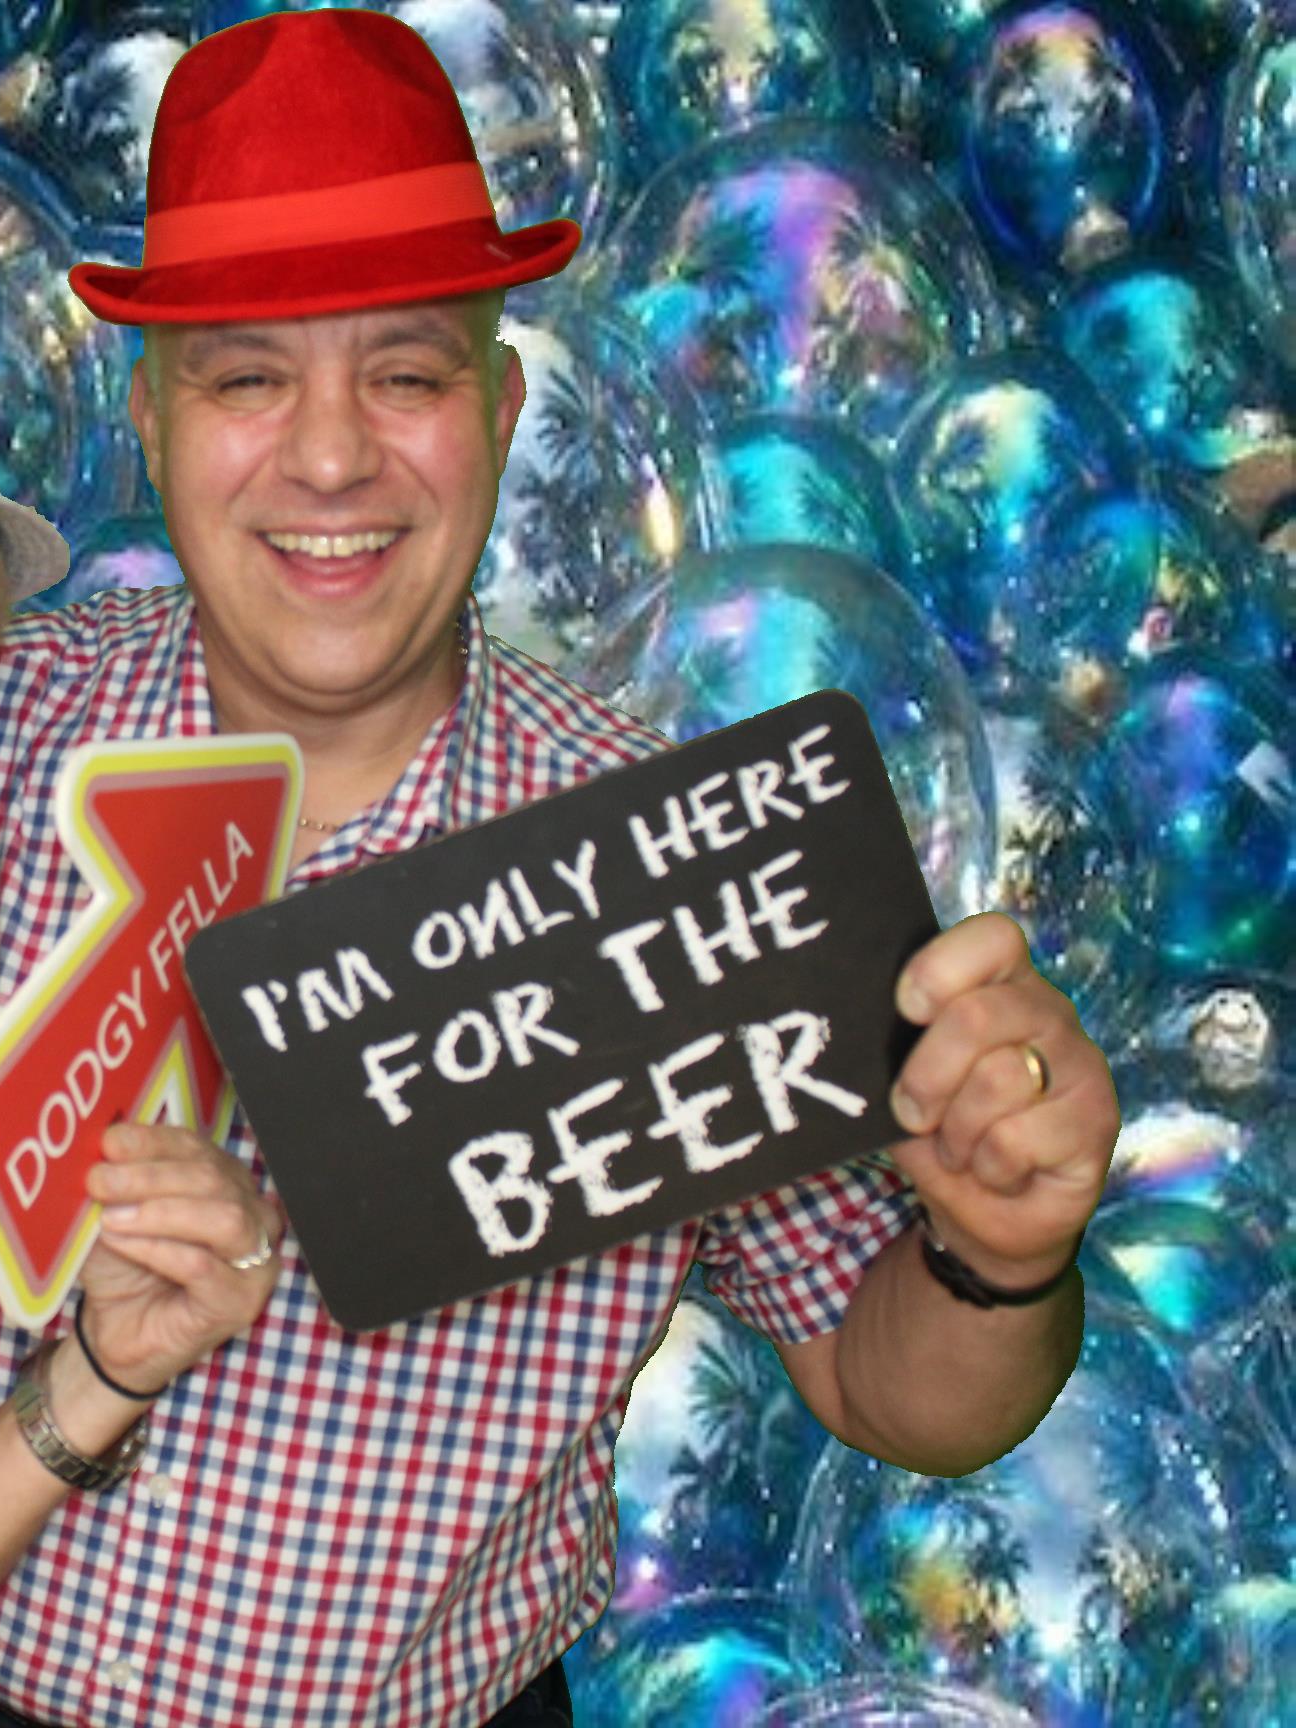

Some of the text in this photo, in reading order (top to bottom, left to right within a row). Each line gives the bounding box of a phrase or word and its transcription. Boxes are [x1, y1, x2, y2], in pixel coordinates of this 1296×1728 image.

[5, 821, 254, 1211] DODGY FELLA
[241, 725, 850, 1052] I'M ONLY HERE
[361, 850, 829, 1126] FOR THE
[448, 1010, 868, 1257] BEER
